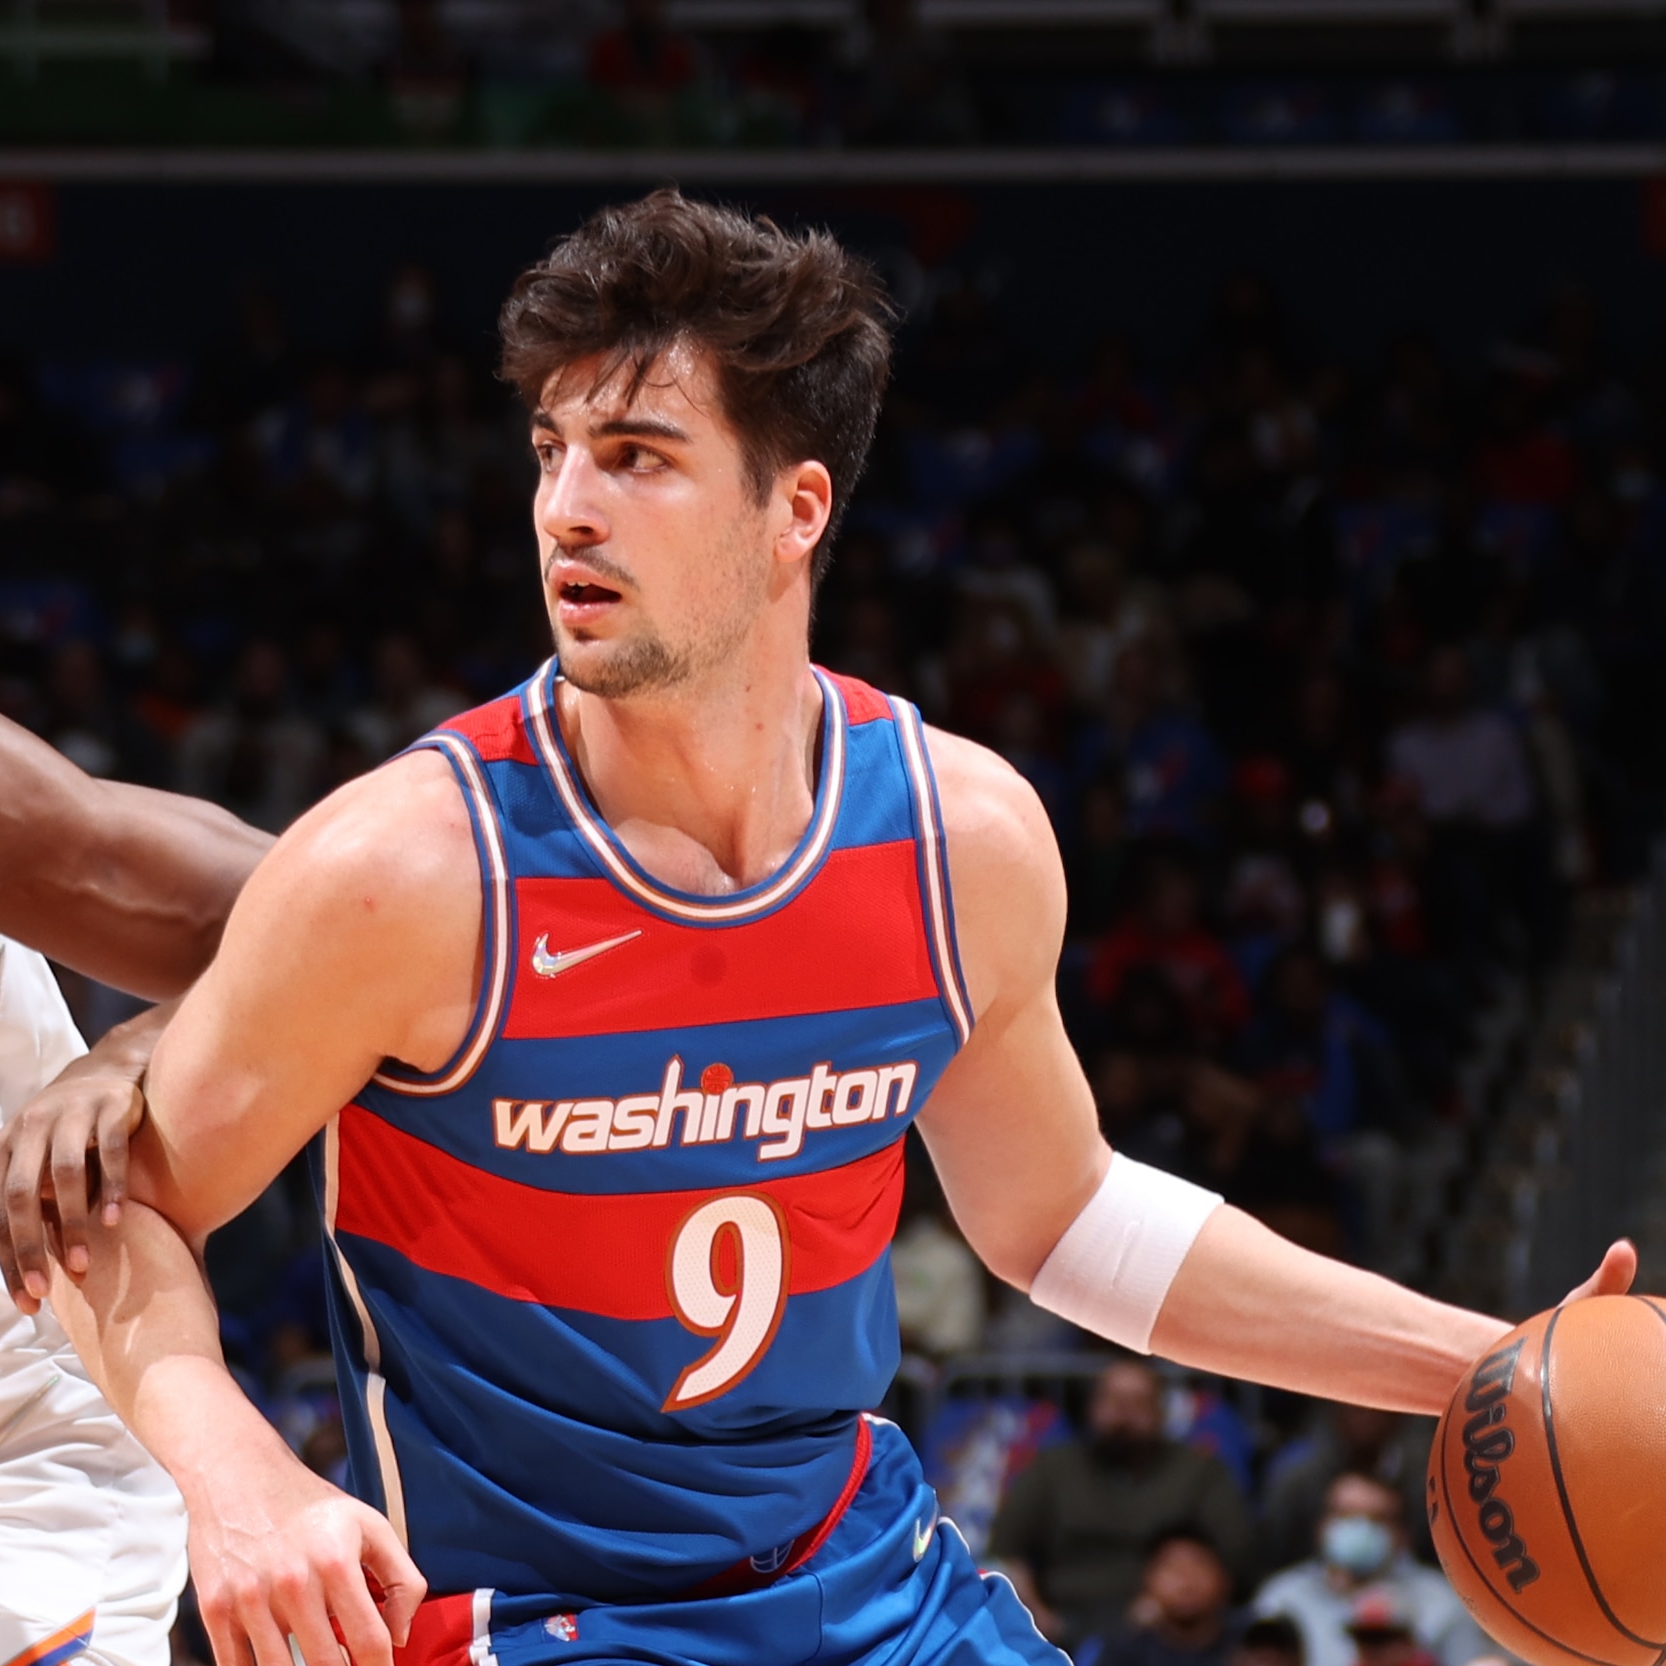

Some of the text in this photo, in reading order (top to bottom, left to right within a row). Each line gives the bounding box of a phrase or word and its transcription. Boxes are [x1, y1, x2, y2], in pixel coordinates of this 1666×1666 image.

[493, 1054, 919, 1163] washington
[661, 1190, 791, 1413] 9
[1463, 1335, 1541, 1595] Wilson
